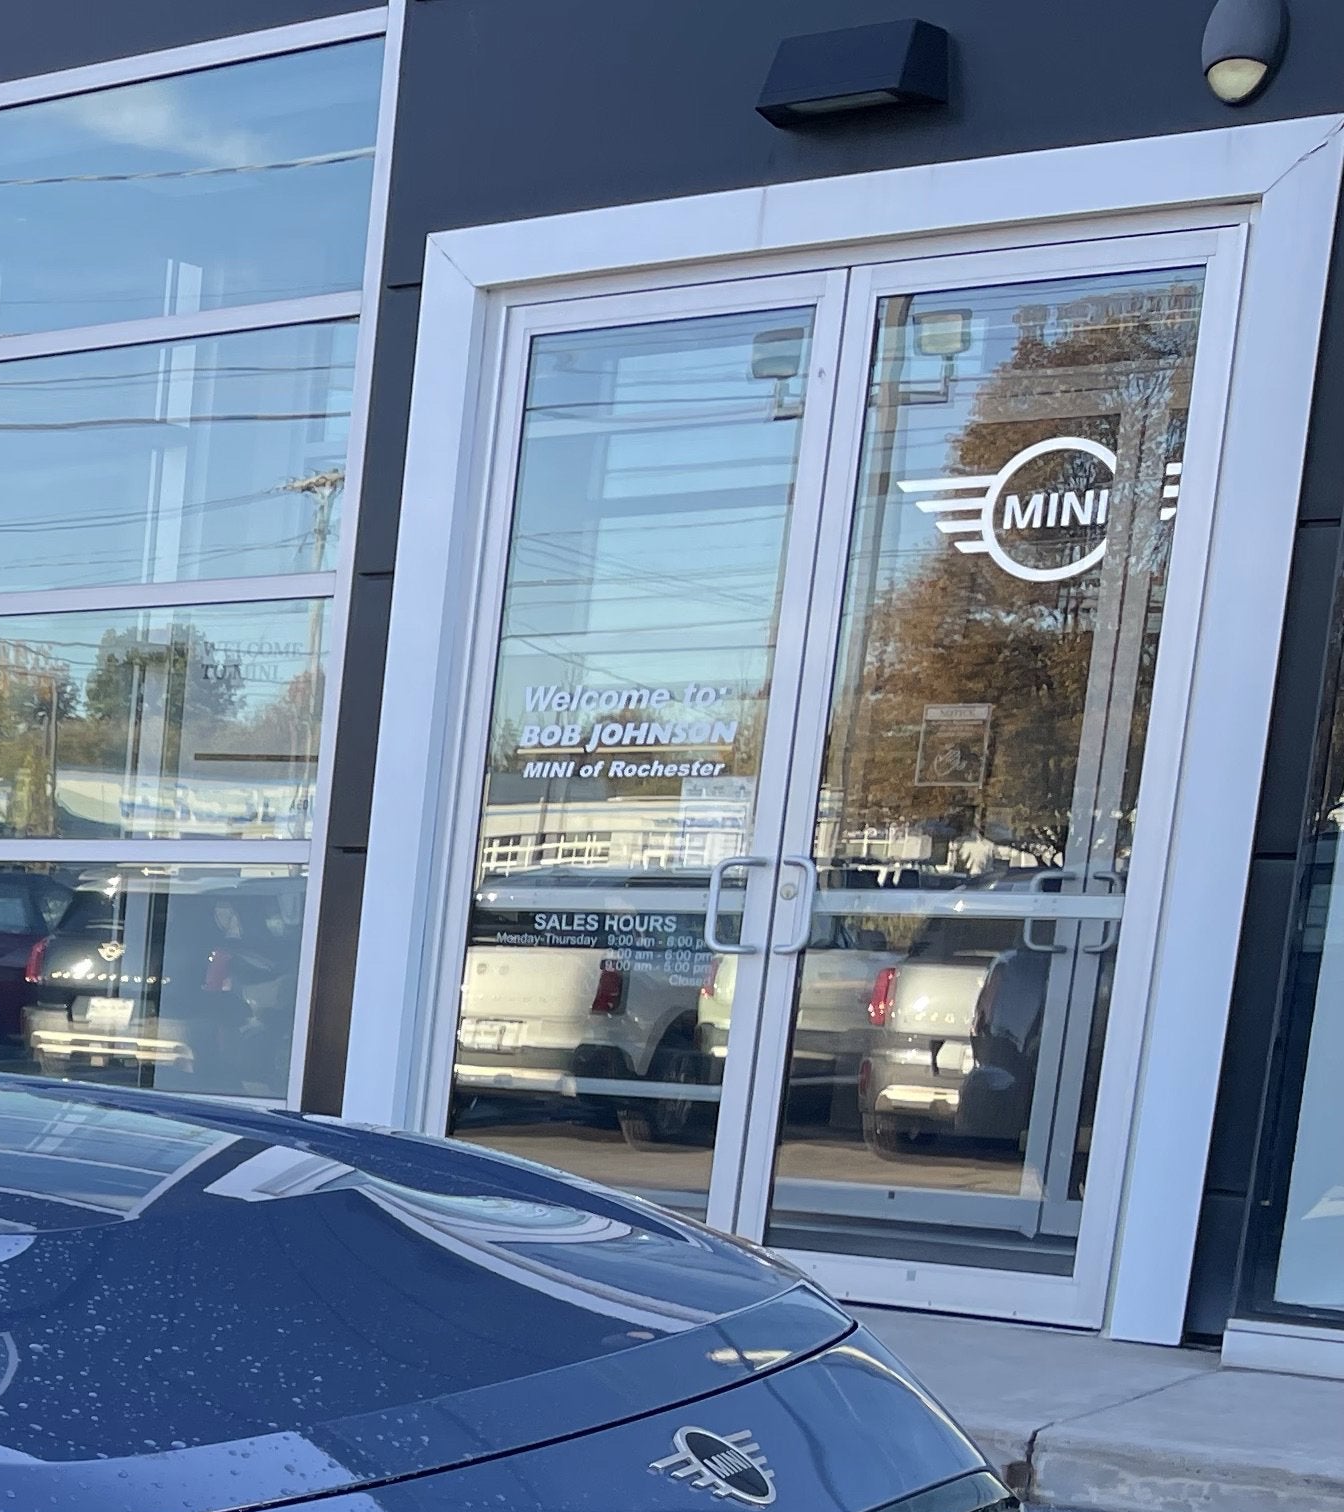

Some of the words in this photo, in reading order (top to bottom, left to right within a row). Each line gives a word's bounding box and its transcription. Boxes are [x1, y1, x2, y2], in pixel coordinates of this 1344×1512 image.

[1003, 488, 1109, 530] MINI
[525, 685, 671, 712] Welcome
[683, 681, 728, 708] to:
[520, 724, 582, 747] BOB
[584, 721, 737, 753] JOHNSON
[523, 761, 575, 779] MINI
[579, 761, 605, 778] of
[608, 760, 726, 779] Rochester
[534, 914, 599, 931] SALES
[605, 915, 677, 932] HOURS
[496, 932, 598, 947] Monday-Thursday
[703, 1450, 753, 1479] MINI
